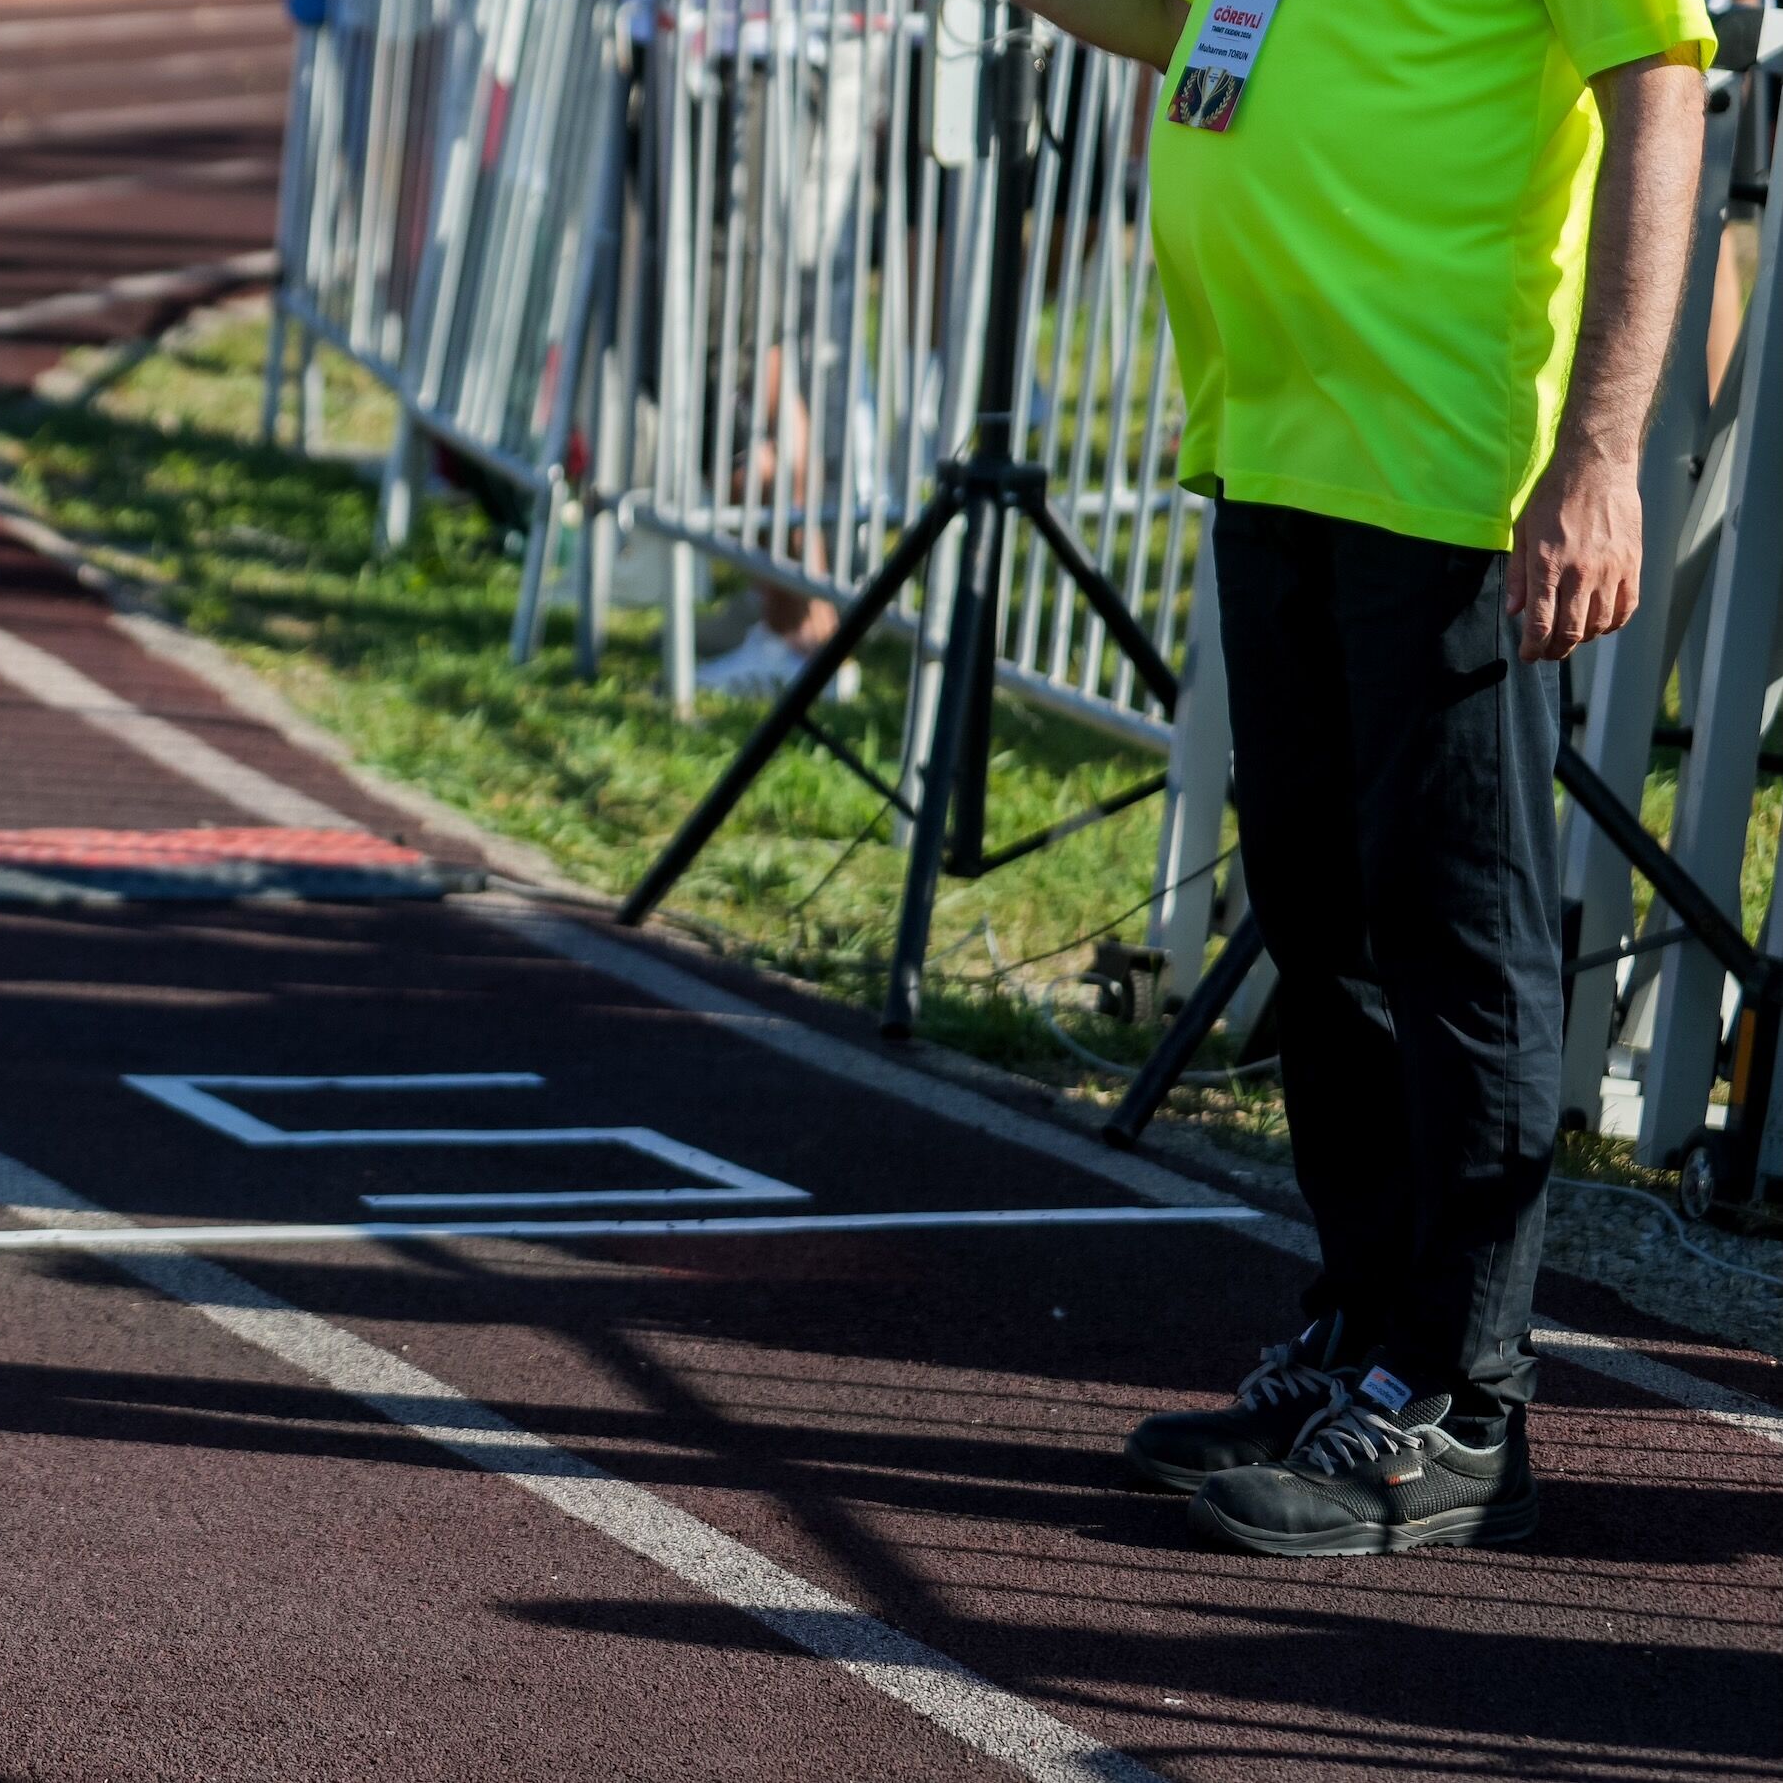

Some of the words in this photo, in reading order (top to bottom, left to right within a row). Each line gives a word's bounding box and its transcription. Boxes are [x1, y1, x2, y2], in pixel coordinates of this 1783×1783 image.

[1214, 5, 1264, 29] GÖREVLİ
[1198, 42, 1228, 57] Muharrem
[1227, 48, 1249, 61] TORUN
